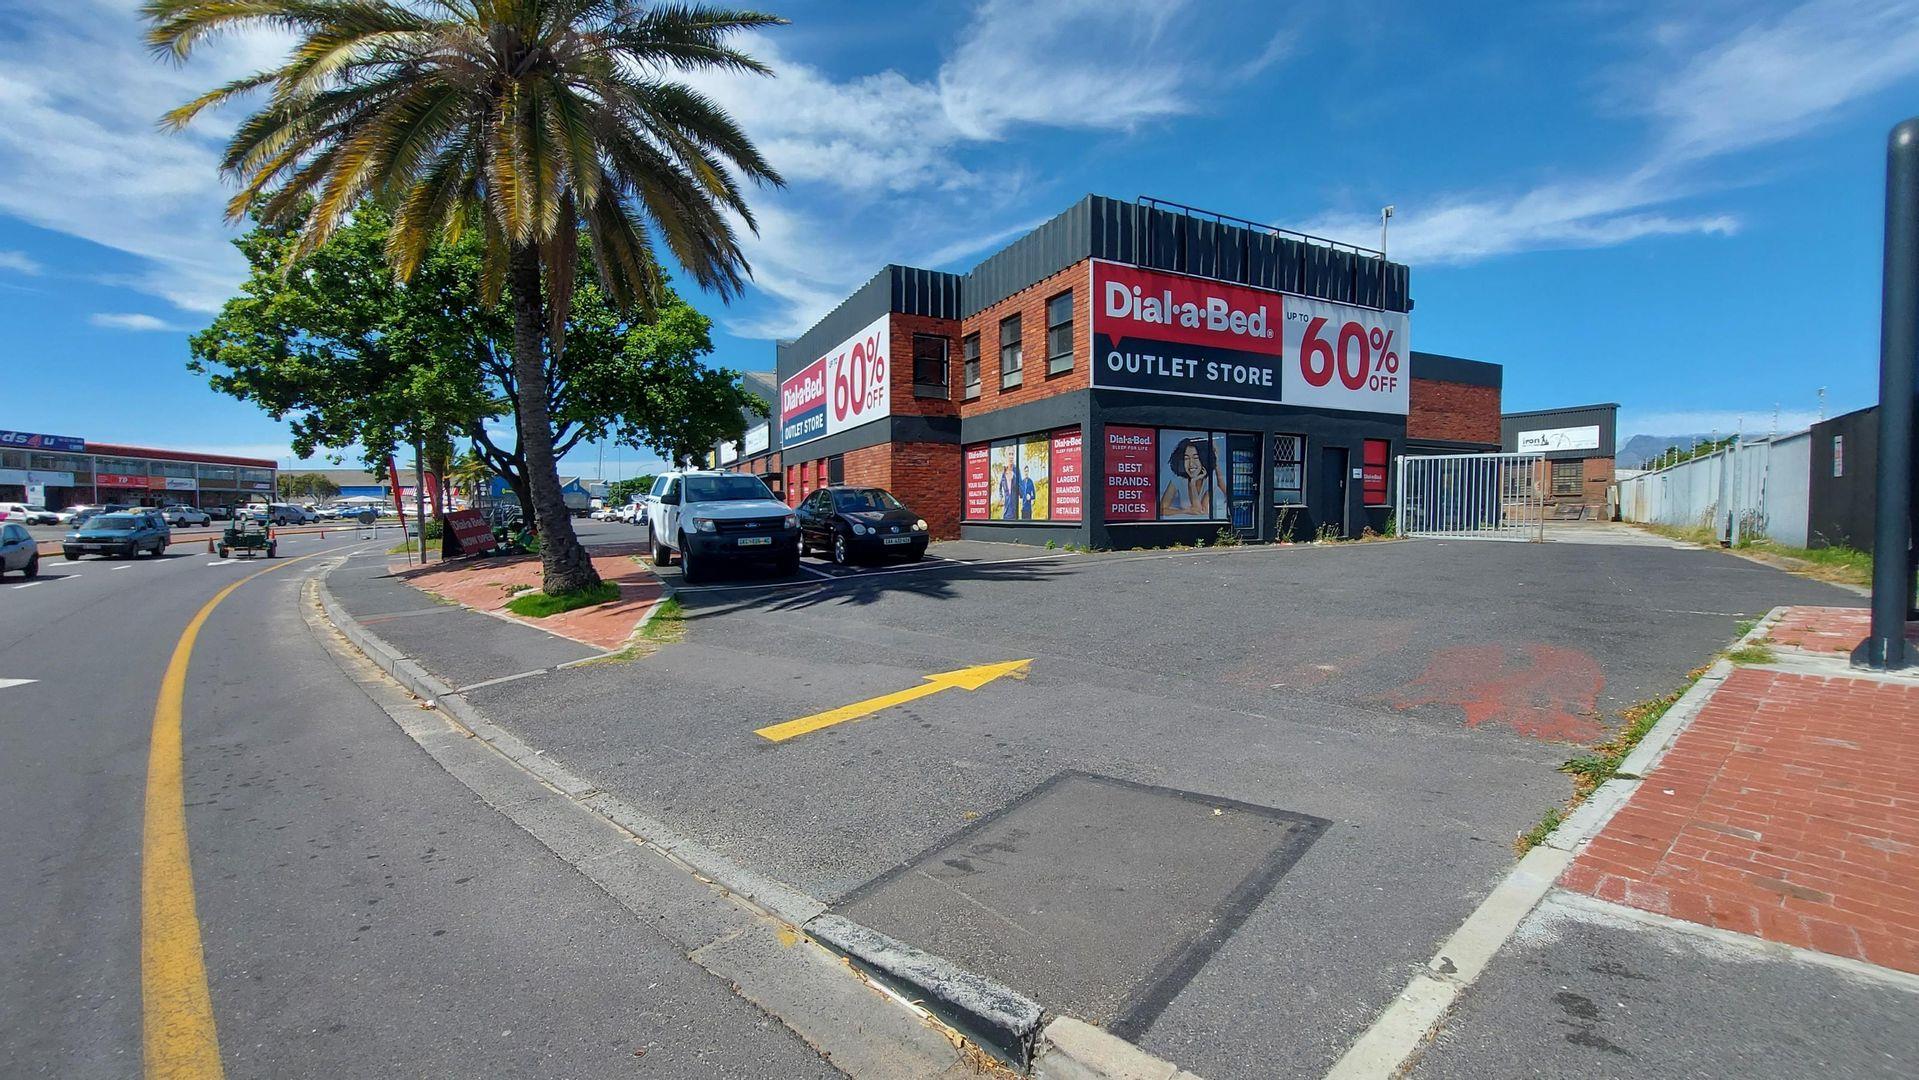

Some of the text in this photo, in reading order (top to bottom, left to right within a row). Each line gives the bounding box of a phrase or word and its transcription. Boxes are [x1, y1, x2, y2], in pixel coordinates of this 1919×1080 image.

[1286, 311, 1309, 323] UP TO
[1300, 316, 1399, 391] 60%
[1107, 351, 1273, 387] OUTLET STORE
[834, 331, 885, 422] 60%
[1369, 376, 1398, 393] OFF
[867, 387, 884, 410] OFF
[784, 413, 824, 440] OUTLET STORE
[1118, 463, 1143, 473] BEST
[1056, 475, 1079, 484] LARGEST
[1108, 476, 1152, 487] BRANDS.
[1055, 486, 1080, 494] BRANDED
[1118, 490, 1143, 500] BEST
[1056, 496, 1079, 504] BEDDING
[1055, 507, 1080, 515] RETAILER
[1111, 503, 1149, 513] PRICES.
